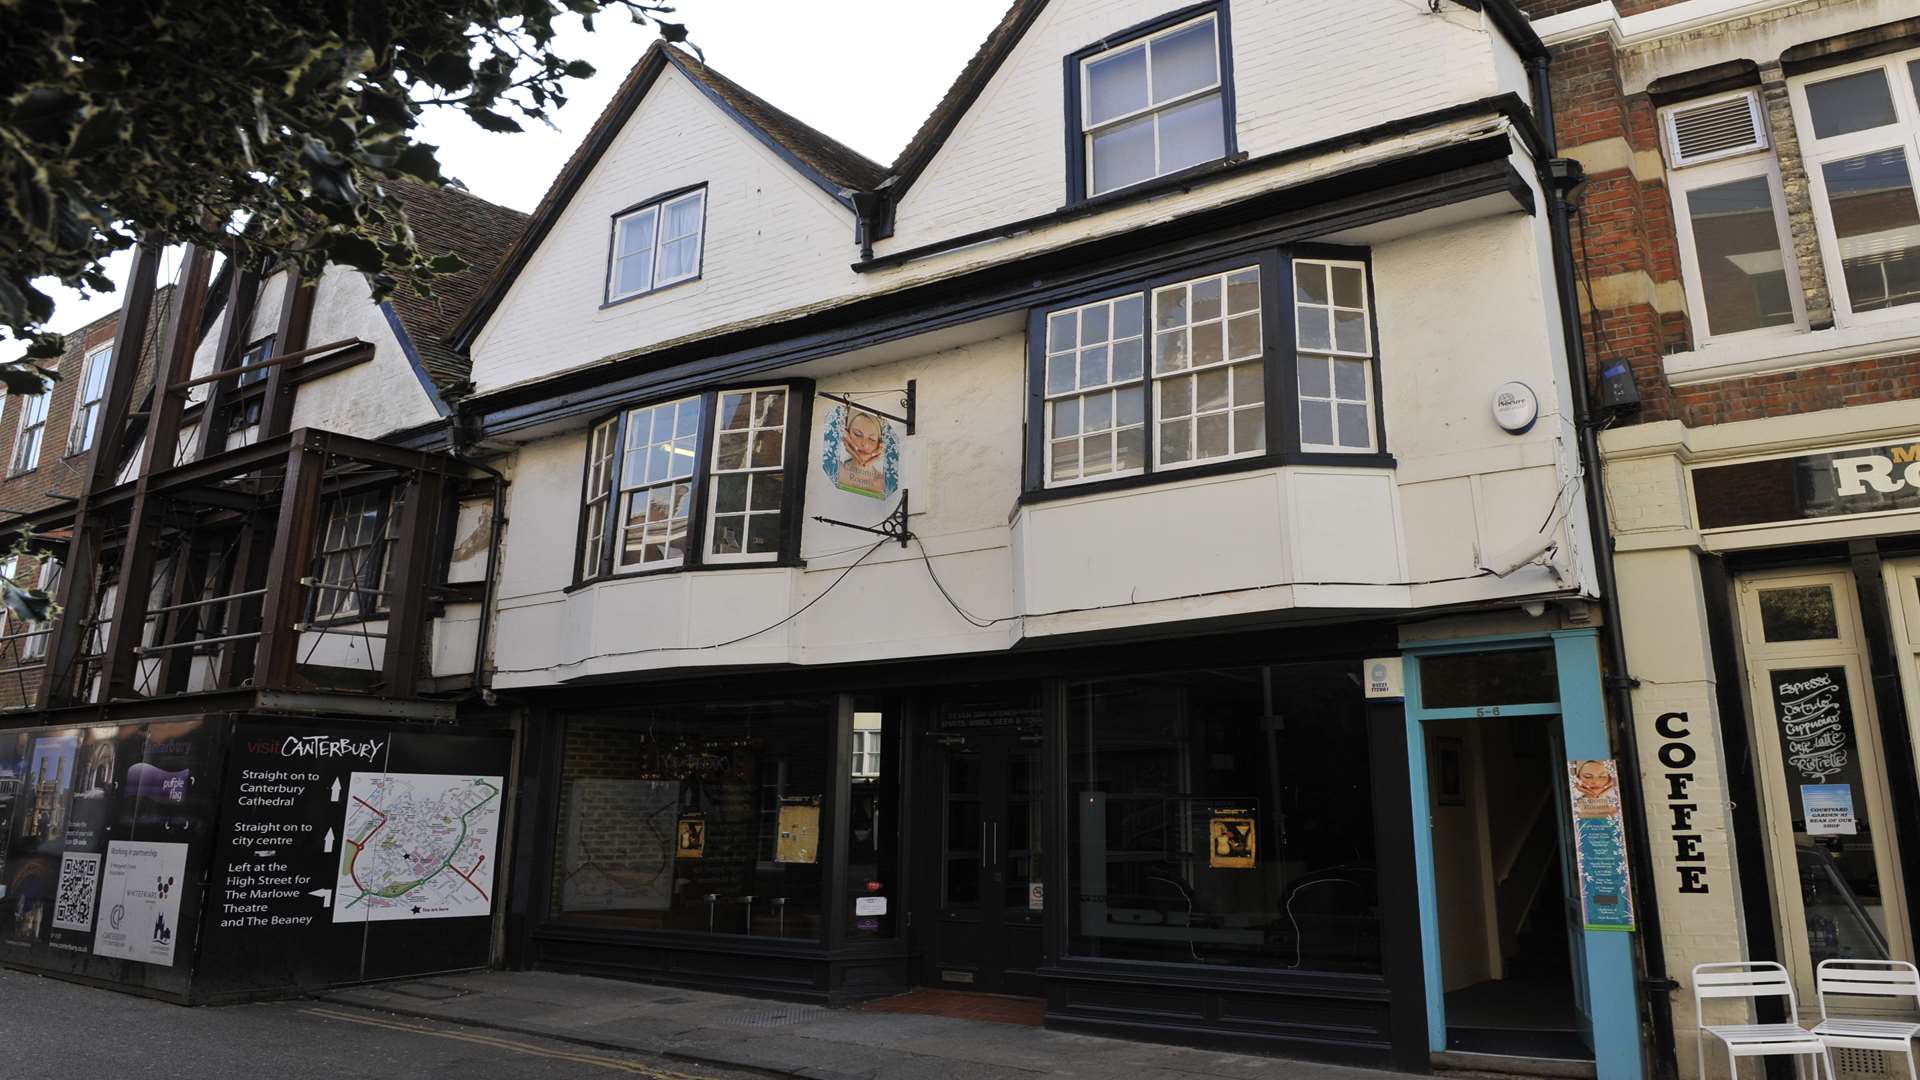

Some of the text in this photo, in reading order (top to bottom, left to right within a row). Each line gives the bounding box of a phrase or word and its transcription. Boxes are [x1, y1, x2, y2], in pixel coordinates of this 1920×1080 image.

[1779, 673, 1832, 695] Espresso
[1476, 706, 1500, 717] 5-6
[247, 735, 384, 763] visit CANTERBURY
[242, 770, 320, 782] Straight on to
[162, 777, 185, 791] purple
[240, 783, 306, 796] Canterbury
[168, 788, 183, 802] flag
[238, 796, 295, 807] Cathedral
[1655, 712, 1709, 894] COFFEE
[234, 822, 313, 834] Straight on to
[232, 837, 293, 848] city centre
[228, 863, 288, 872] Left at the
[226, 875, 311, 888] High Street for
[225, 889, 301, 899] The Marlowe
[223, 903, 268, 913] Theatre
[220, 916, 313, 930] and The Beaney
